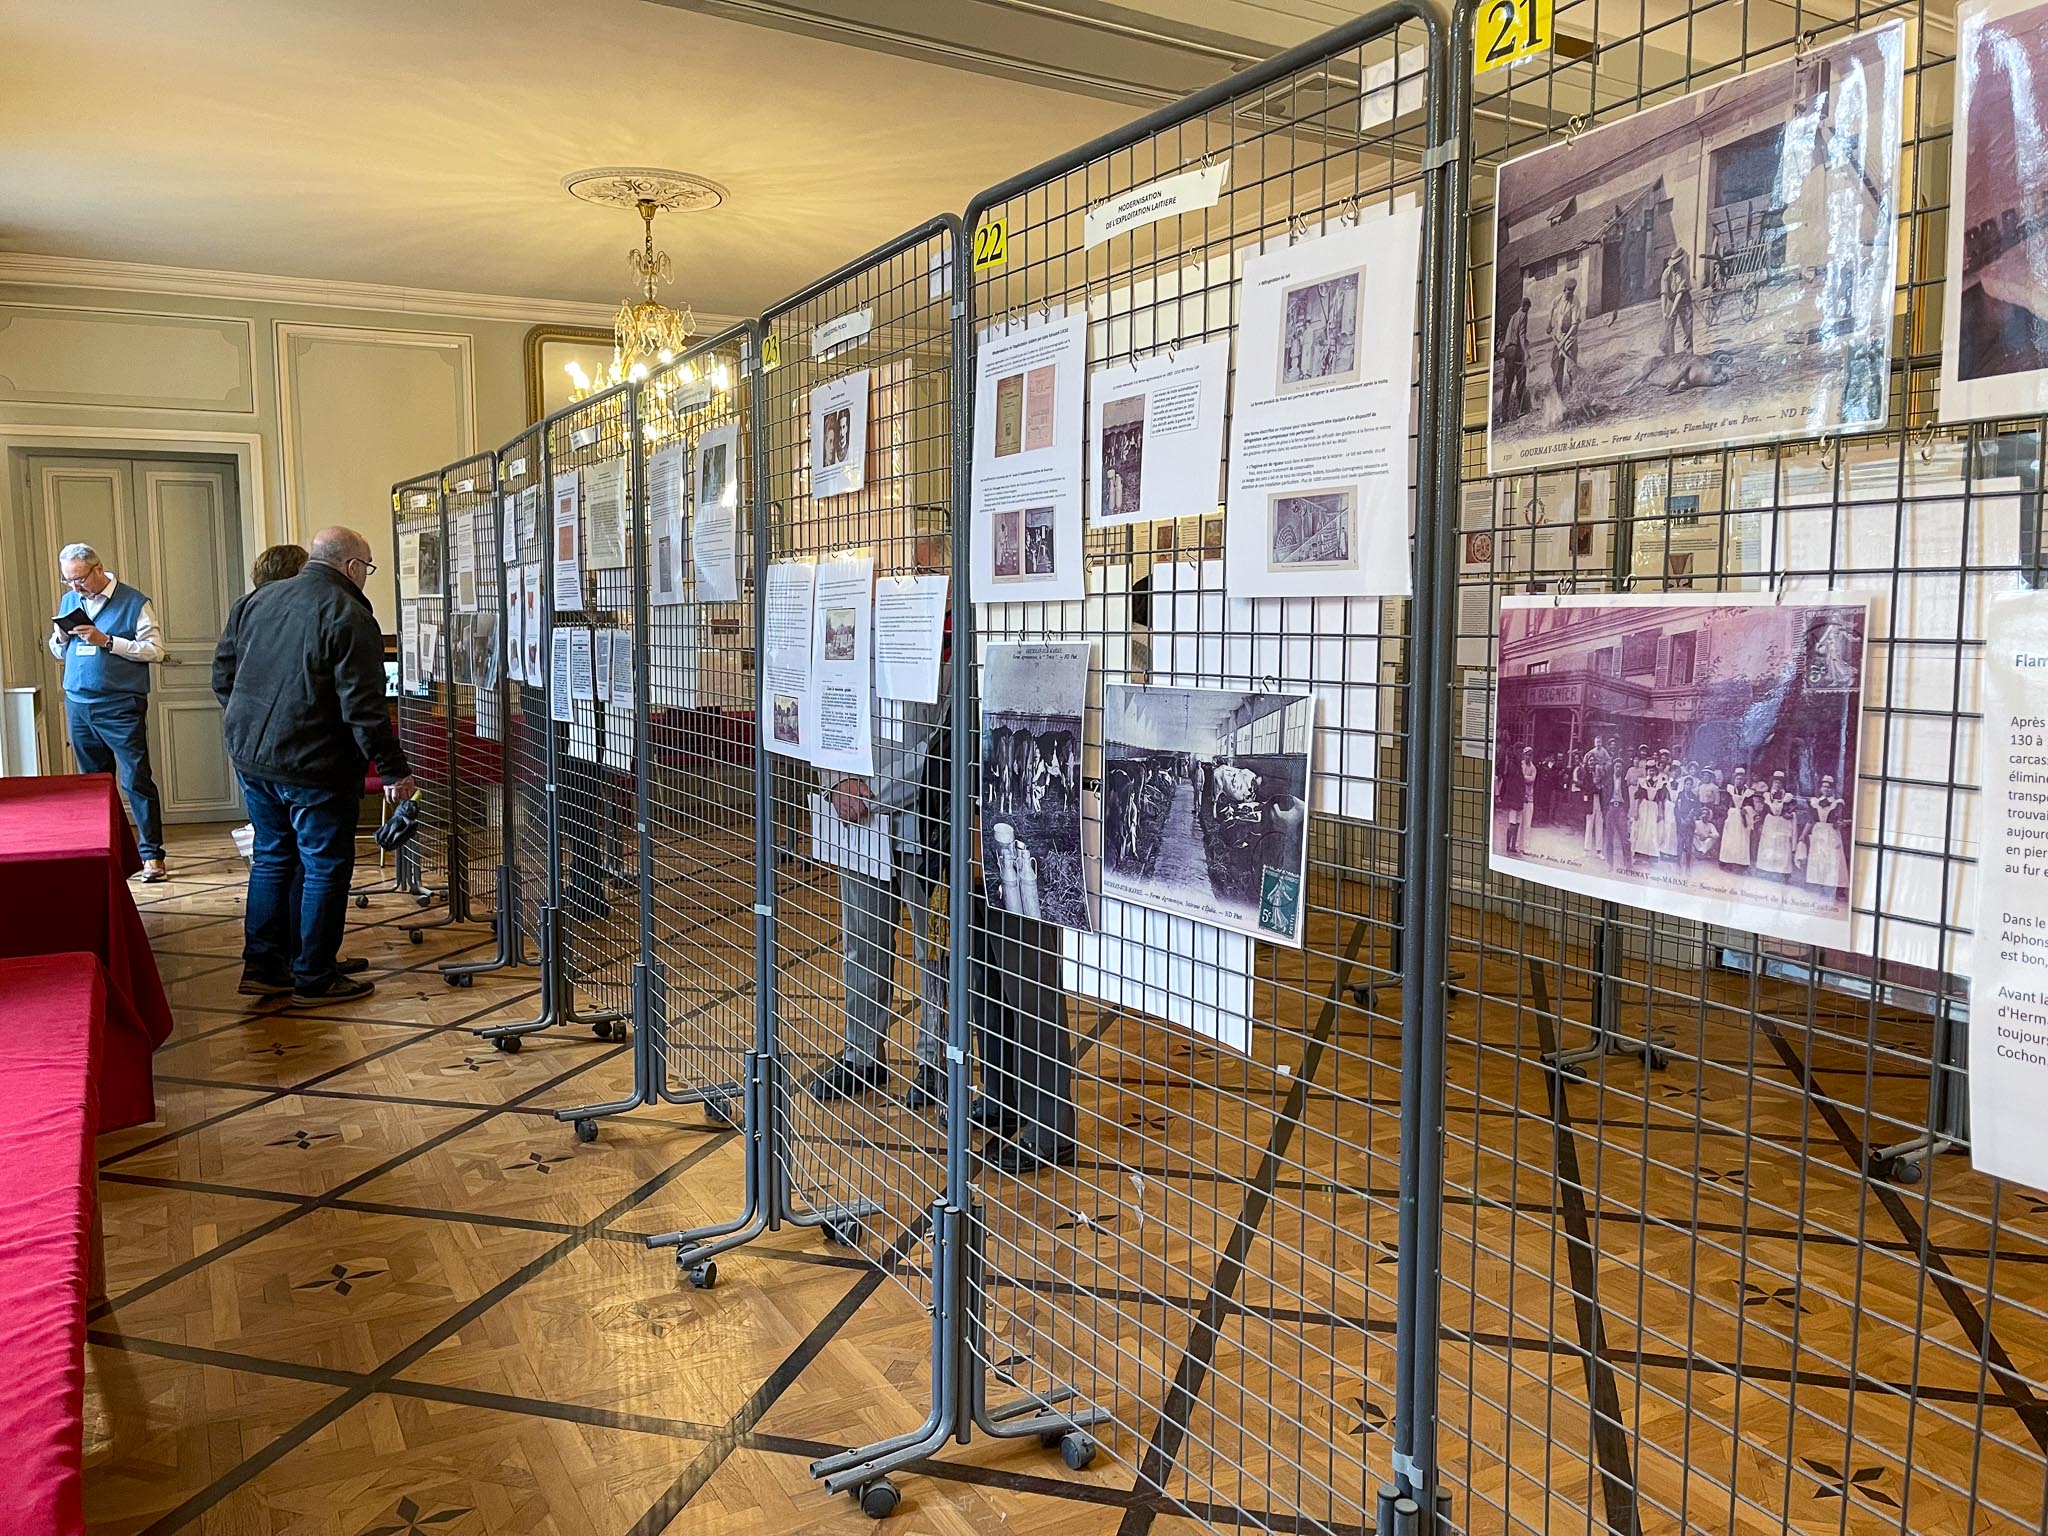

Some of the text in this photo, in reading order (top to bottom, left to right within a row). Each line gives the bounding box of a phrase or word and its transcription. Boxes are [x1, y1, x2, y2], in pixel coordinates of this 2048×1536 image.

[1485, 0, 1543, 62] 21
[1118, 191, 1162, 212] MODERNISATION
[976, 223, 1003, 266] 22
[764, 335, 777, 366] 23
[1780, 408, 1797, 419] ND
[2011, 715, 2046, 729] Après
[2010, 734, 2043, 746] 130 à
[2009, 755, 2048, 765] carcas
[2008, 770, 2048, 783] élimin
[2008, 790, 2048, 805] transp
[2006, 846, 2021, 856] en
[2005, 864, 2020, 874] au
[2023, 863, 2041, 877] fur
[2002, 912, 2046, 928] Dans le
[2000, 951, 2048, 968] est bon,
[1998, 985, 2036, 1003] Avant
[1998, 1006, 2048, 1026] d'Herm
